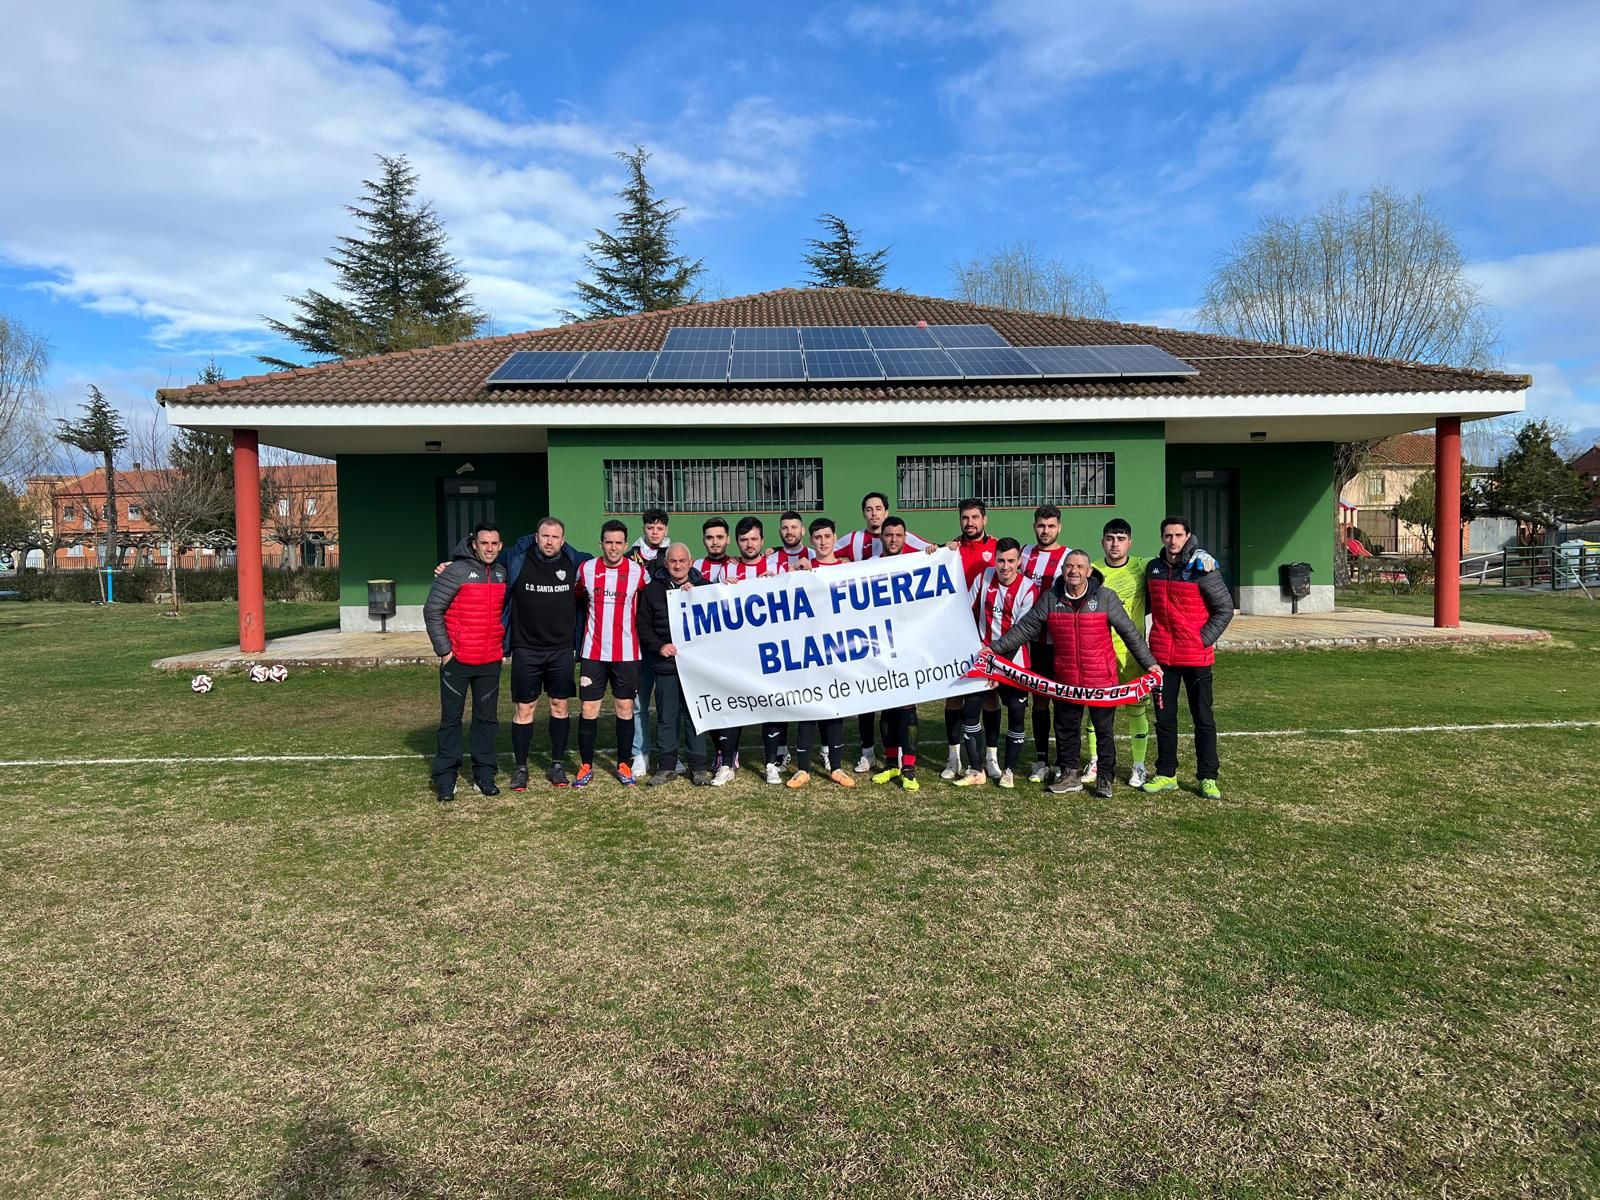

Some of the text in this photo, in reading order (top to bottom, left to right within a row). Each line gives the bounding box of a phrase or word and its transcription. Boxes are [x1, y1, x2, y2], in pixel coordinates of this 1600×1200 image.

[536, 584, 554, 593] SANTA
[680, 563, 956, 642] ¡MUCHA FUERZA
[696, 694, 722, 719] ¡Te
[727, 686, 823, 712] esperamos
[828, 678, 850, 699] de
[855, 669, 909, 695] vuelta
[1002, 665, 1131, 700] CD SANTA CROYA
